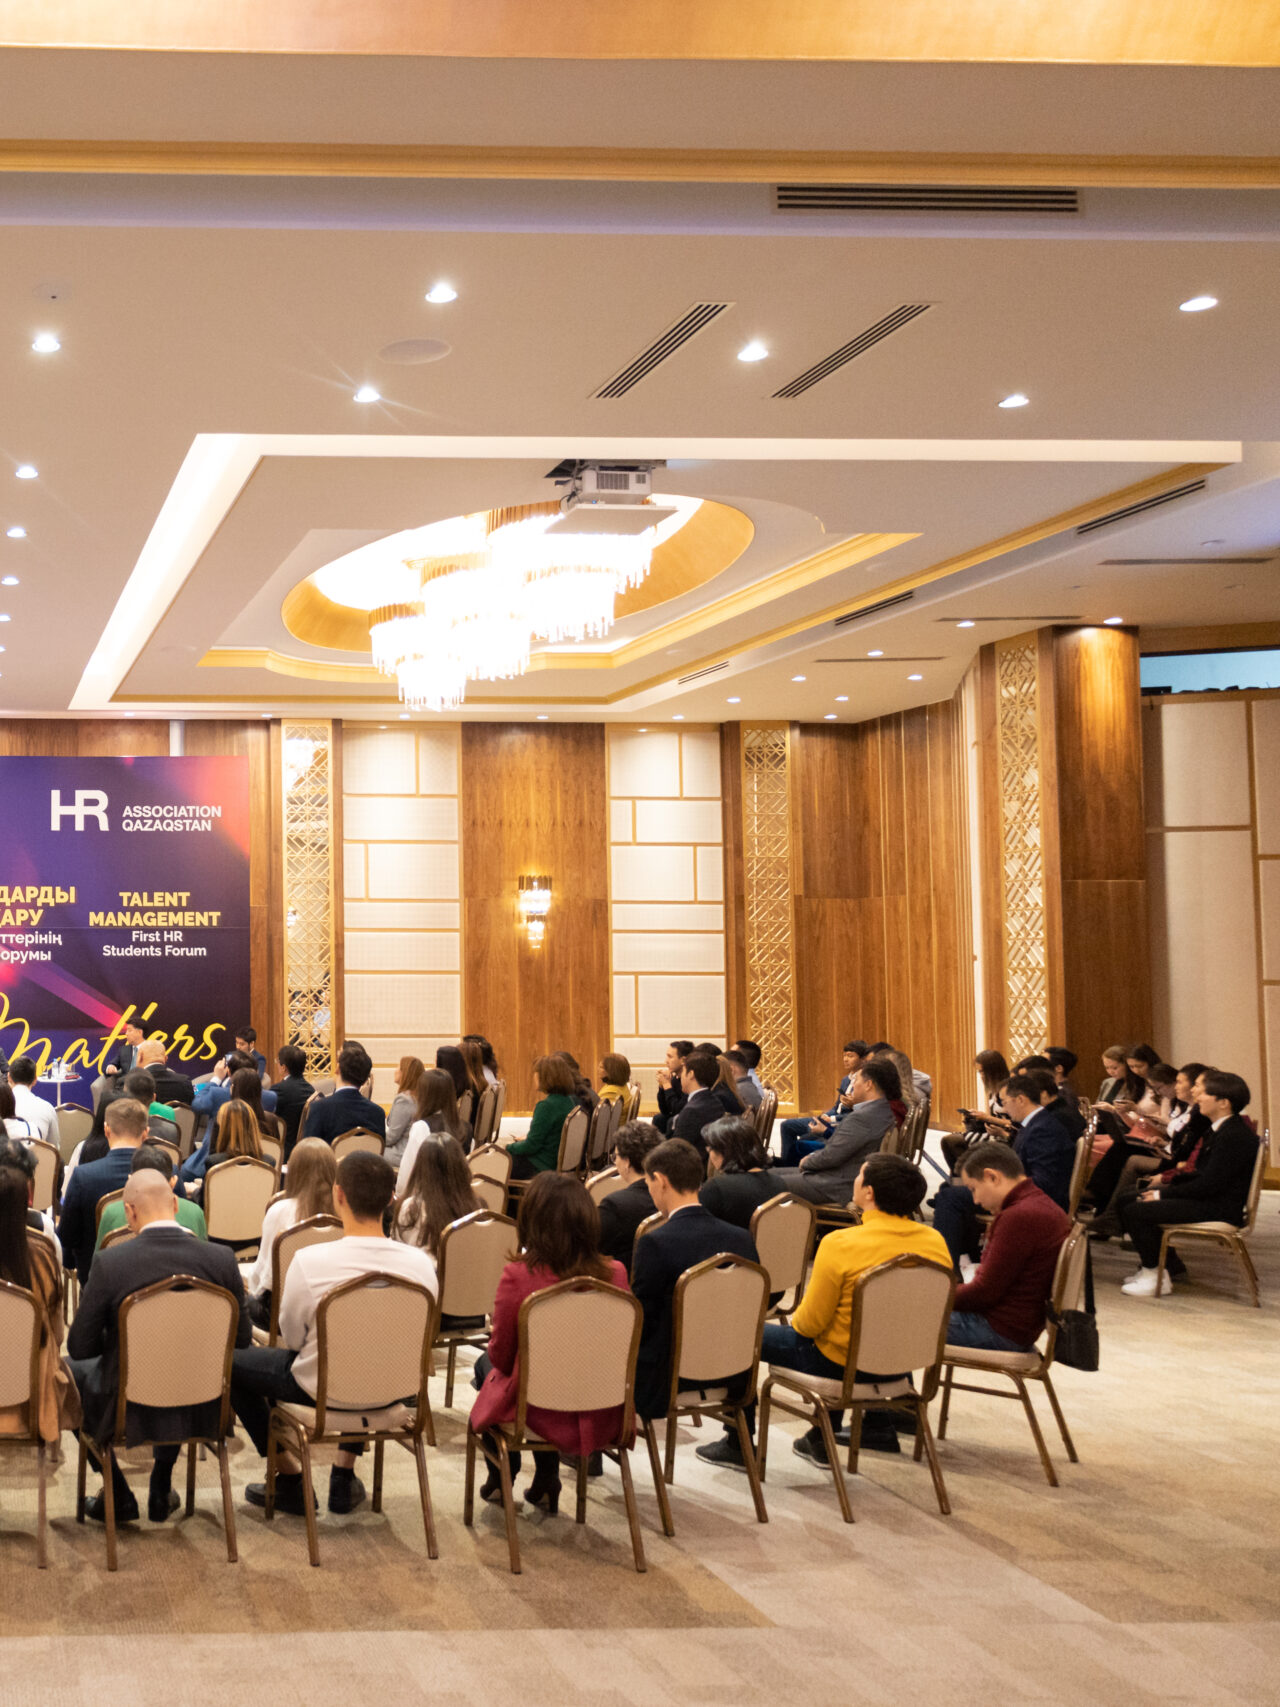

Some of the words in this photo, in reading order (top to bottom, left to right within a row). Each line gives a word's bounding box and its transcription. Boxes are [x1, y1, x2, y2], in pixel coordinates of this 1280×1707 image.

[50, 789, 109, 831] HR
[122, 805, 221, 818] ASSOCIATION
[122, 819, 212, 832] QAZAQSTAN
[118, 891, 191, 907] TALENT
[89, 911, 221, 926] MANAGEMENT
[131, 930, 161, 942] First
[163, 930, 183, 942] HR
[102, 945, 162, 957] Students
[164, 945, 207, 957] Forum
